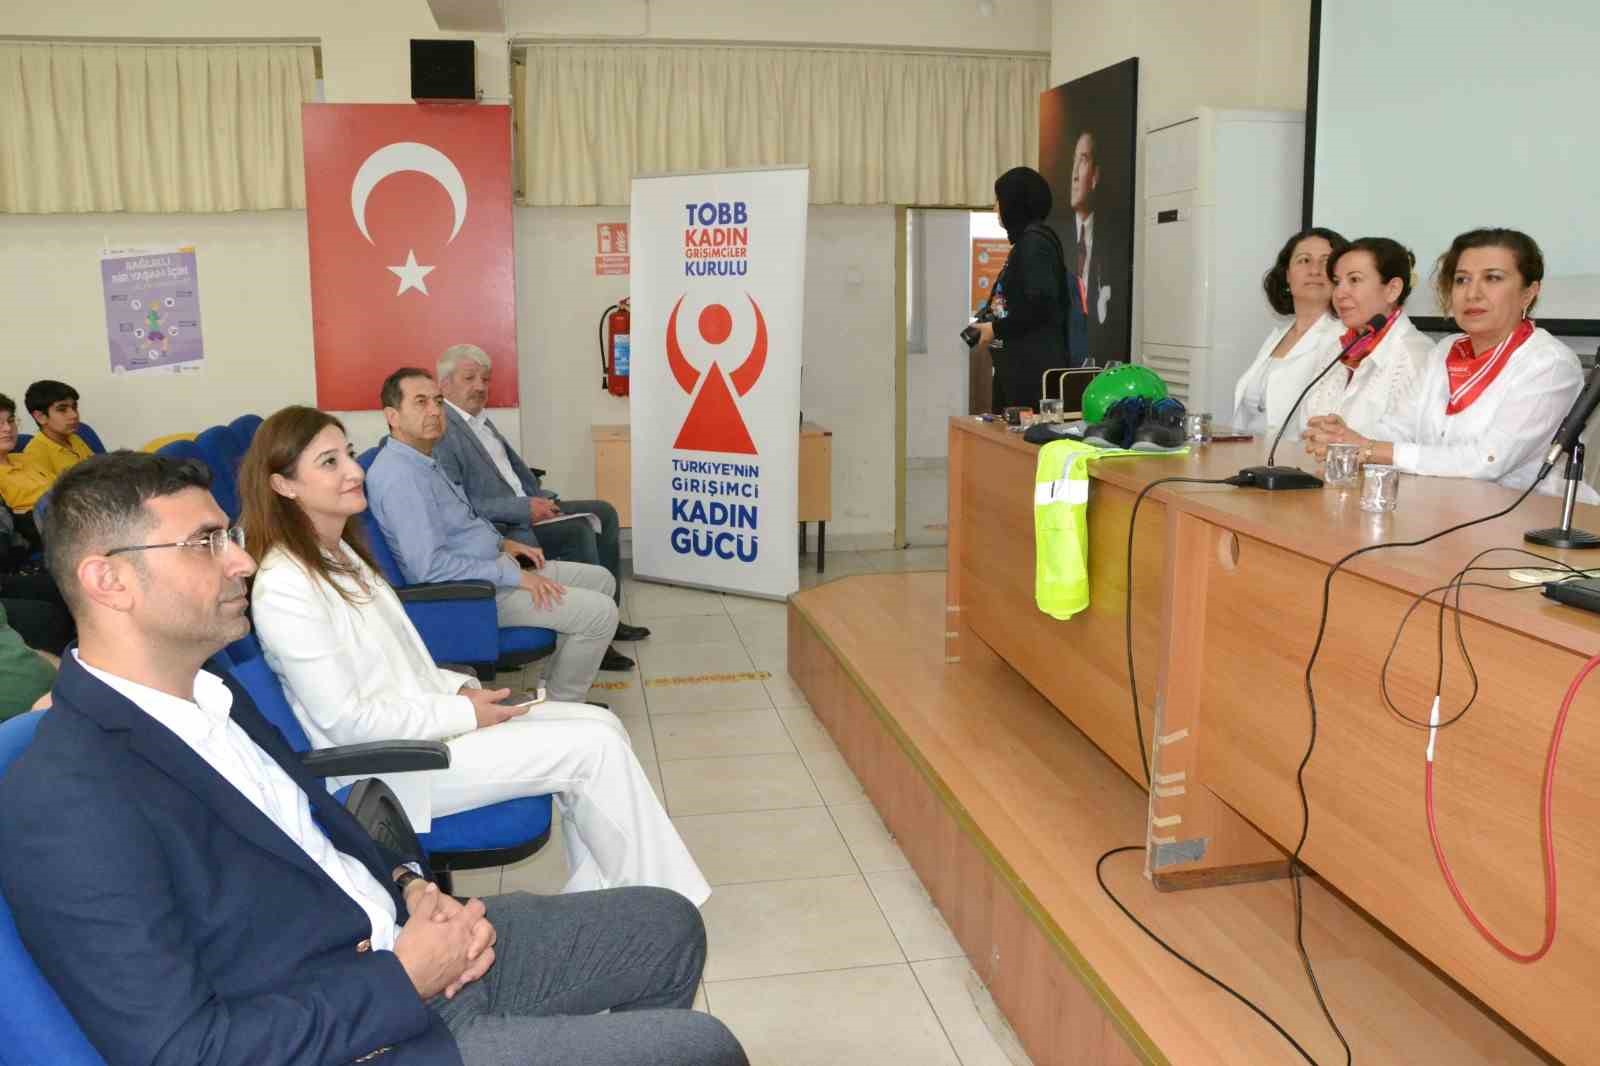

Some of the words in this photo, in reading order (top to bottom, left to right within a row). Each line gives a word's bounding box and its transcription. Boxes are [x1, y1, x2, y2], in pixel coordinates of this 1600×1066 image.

[686, 202, 747, 225] TOBB
[685, 227, 748, 247] KADIN
[685, 260, 748, 276] KURULU
[671, 459, 759, 477] TÜRKİYE'NİN
[671, 477, 760, 498] GİRİŞİMCİ
[671, 497, 758, 530] KADIN
[671, 526, 759, 563] GÜCÜ
